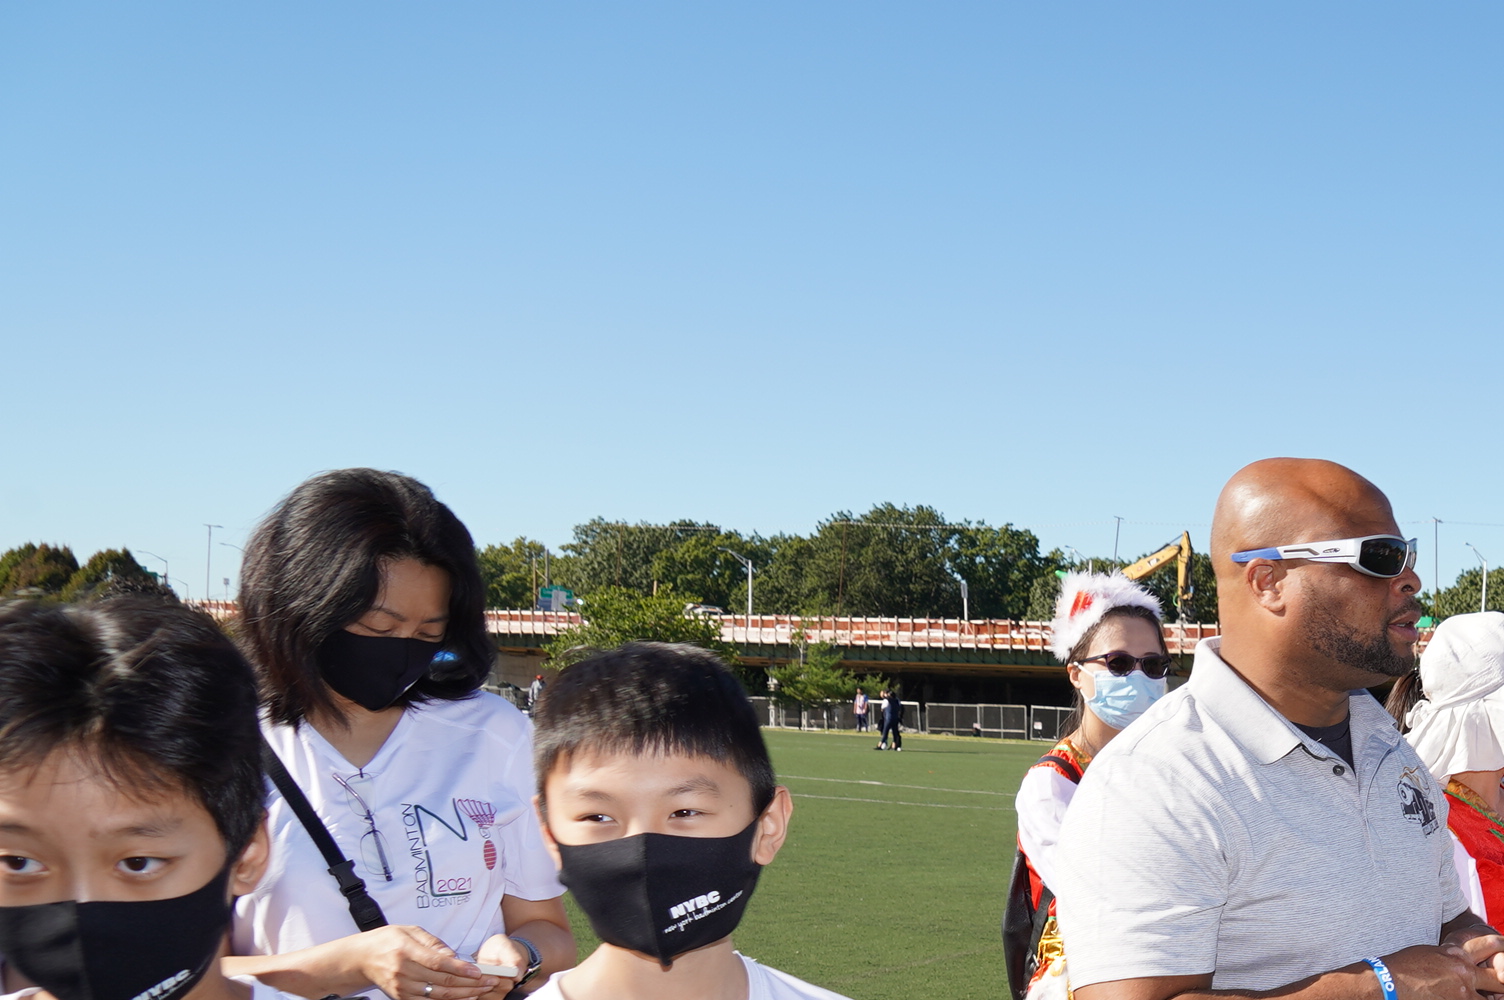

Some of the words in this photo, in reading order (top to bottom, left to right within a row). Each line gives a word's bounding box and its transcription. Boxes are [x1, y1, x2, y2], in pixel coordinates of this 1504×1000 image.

[401, 803, 430, 909] BADMINTON
[437, 877, 472, 892] 2021
[668, 890, 721, 919] NYBC
